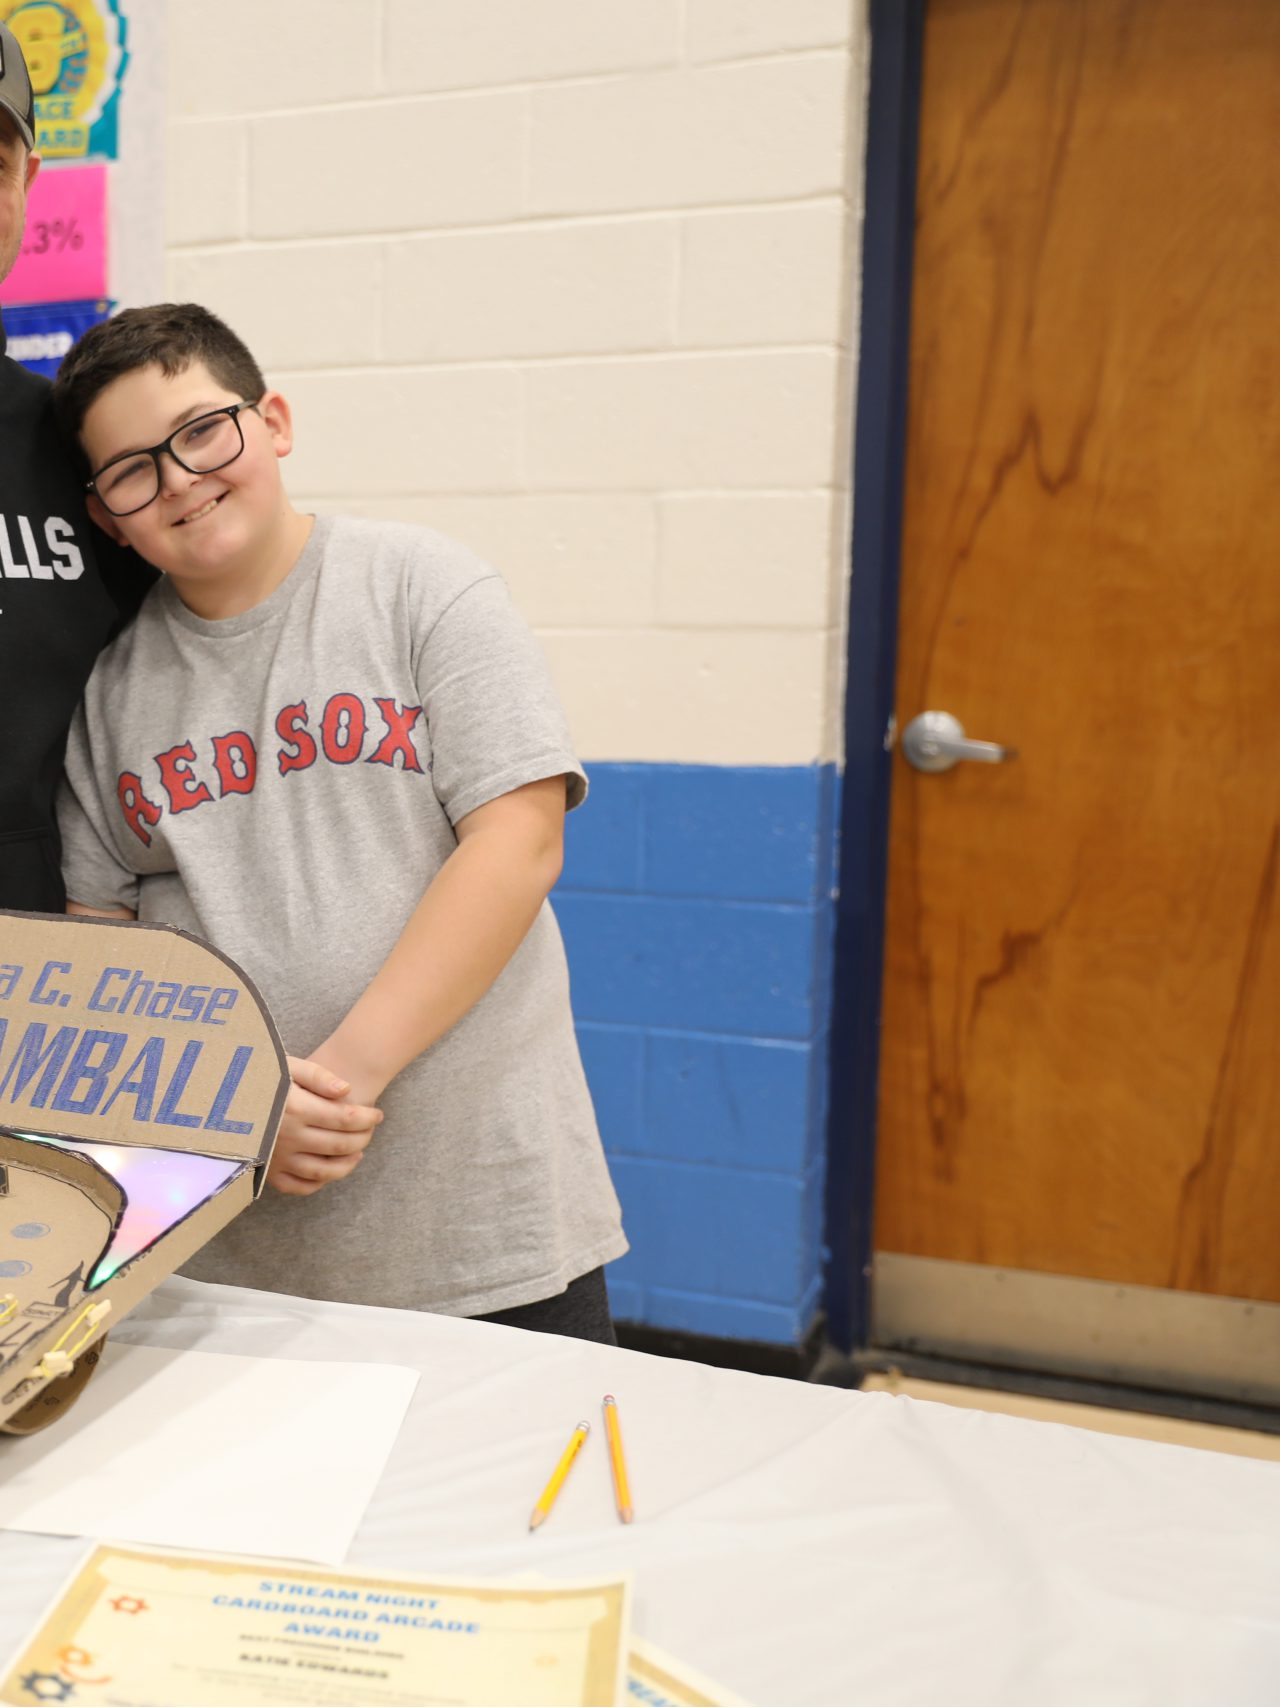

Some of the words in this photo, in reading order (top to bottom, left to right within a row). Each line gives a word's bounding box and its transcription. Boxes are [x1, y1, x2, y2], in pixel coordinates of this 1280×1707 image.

[38, 129, 83, 147] ARD
[117, 730, 258, 848] RED
[274, 692, 425, 778] SOX
[29, 960, 72, 1009] C.
[86, 967, 239, 1026] Chase
[259, 1580, 360, 1601] STREAM
[365, 1593, 439, 1611] NIGHT
[211, 1594, 369, 1621] CARDBOARD
[375, 1612, 481, 1635] ARCADE
[284, 1621, 381, 1643] AWARD
